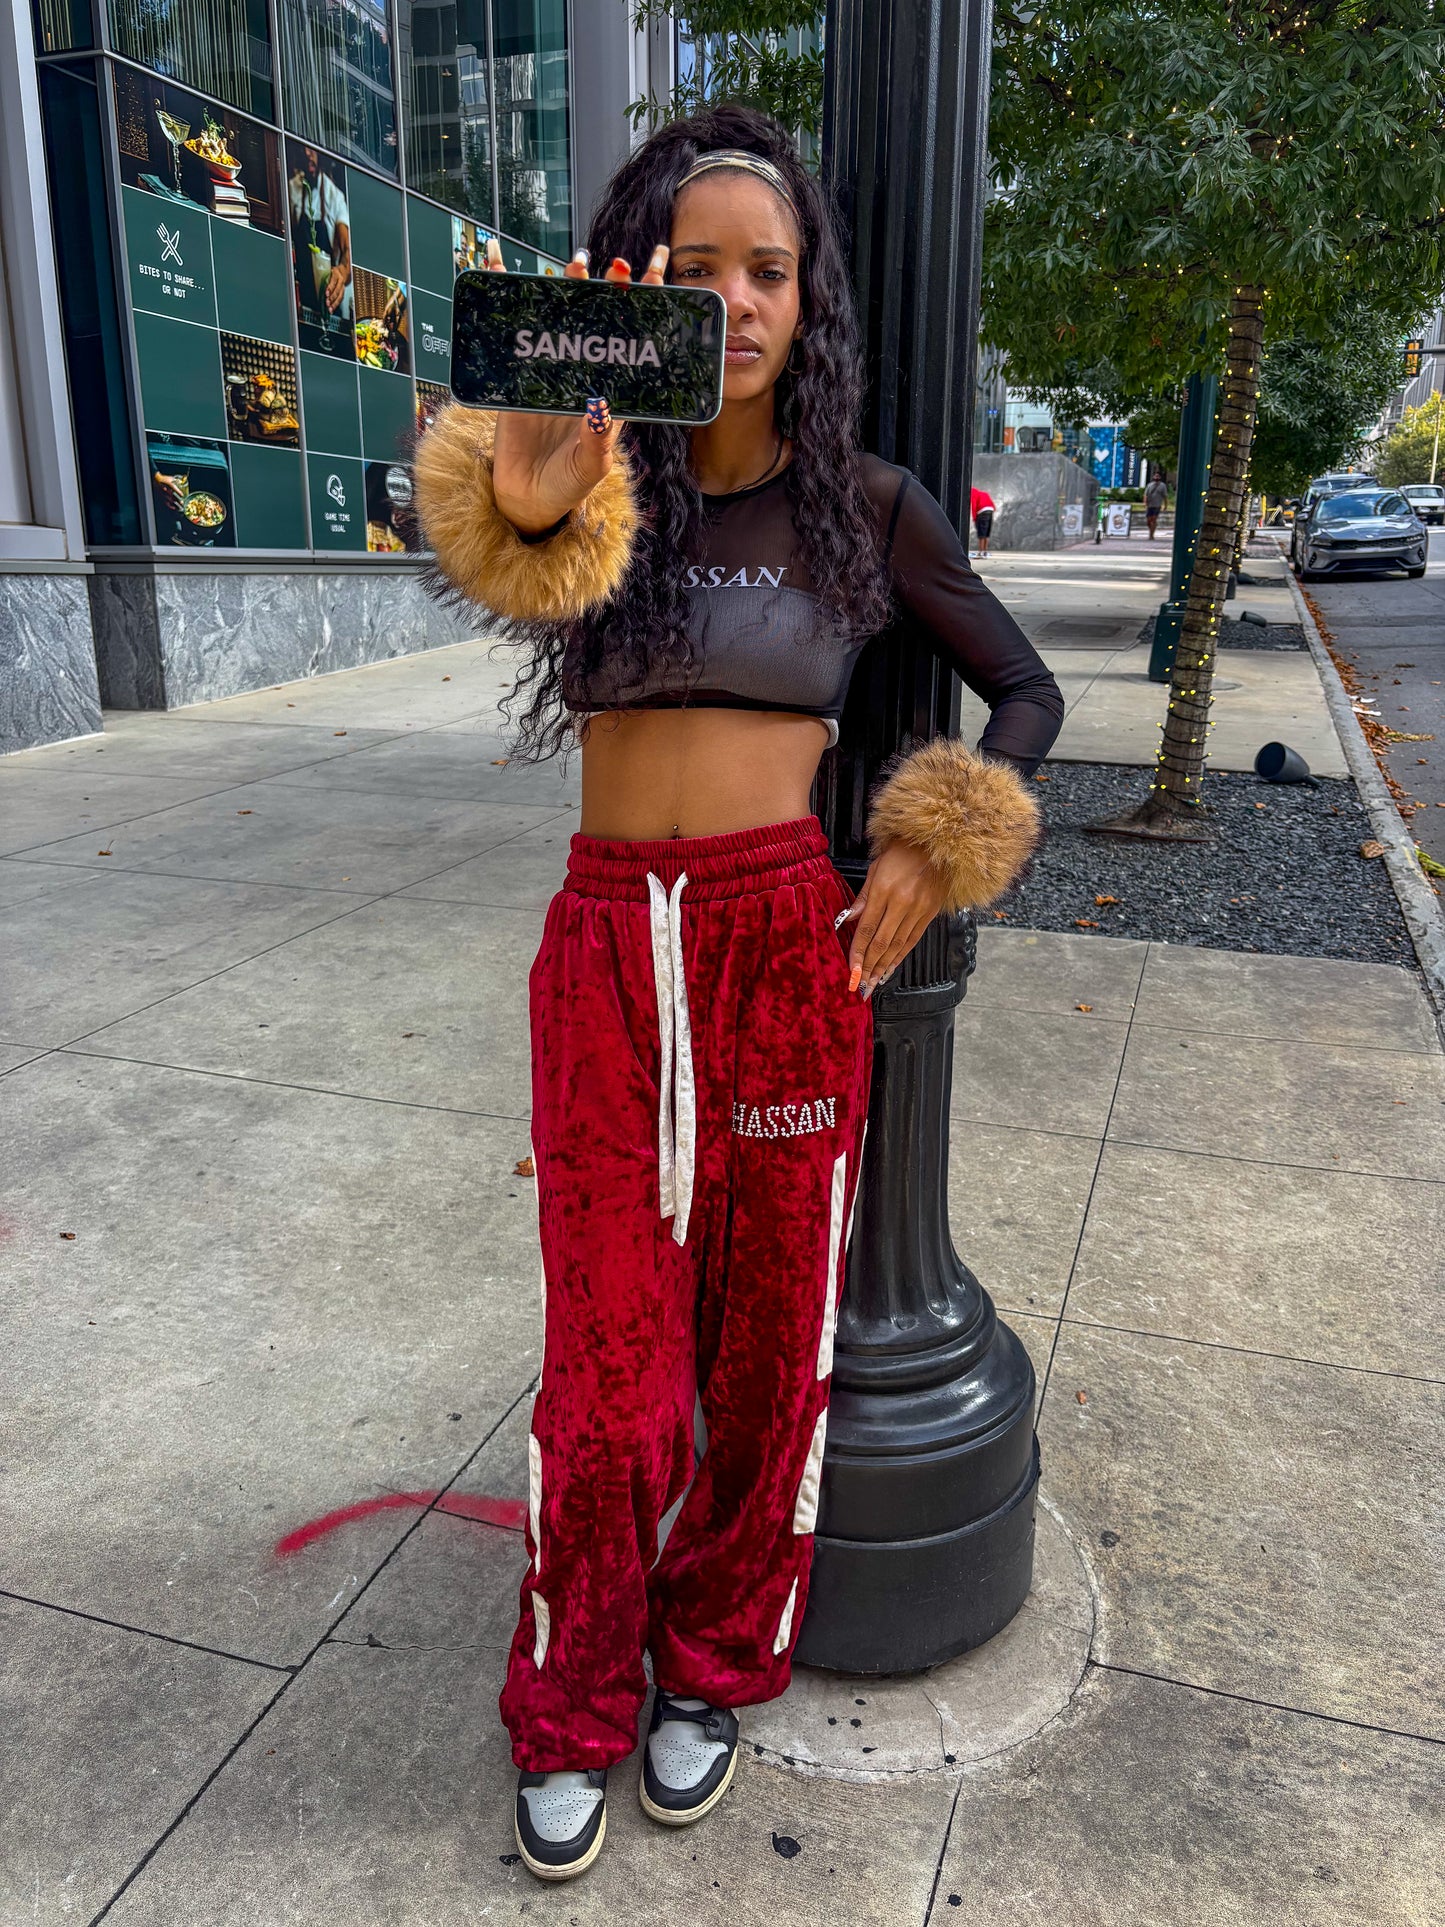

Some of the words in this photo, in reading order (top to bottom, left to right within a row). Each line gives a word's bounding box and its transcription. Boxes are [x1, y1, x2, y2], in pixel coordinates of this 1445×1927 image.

[139, 264, 160, 278] BITES
[163, 271, 172, 281] TO
[174, 274, 205, 290] SHARE...
[162, 284, 171, 295] OR
[174, 287, 186, 299] NOT
[421, 322, 434, 333] THE
[514, 329, 661, 368] SANGRIA
[681, 565, 788, 588] SSAN
[732, 1097, 836, 1139] HASSAN
